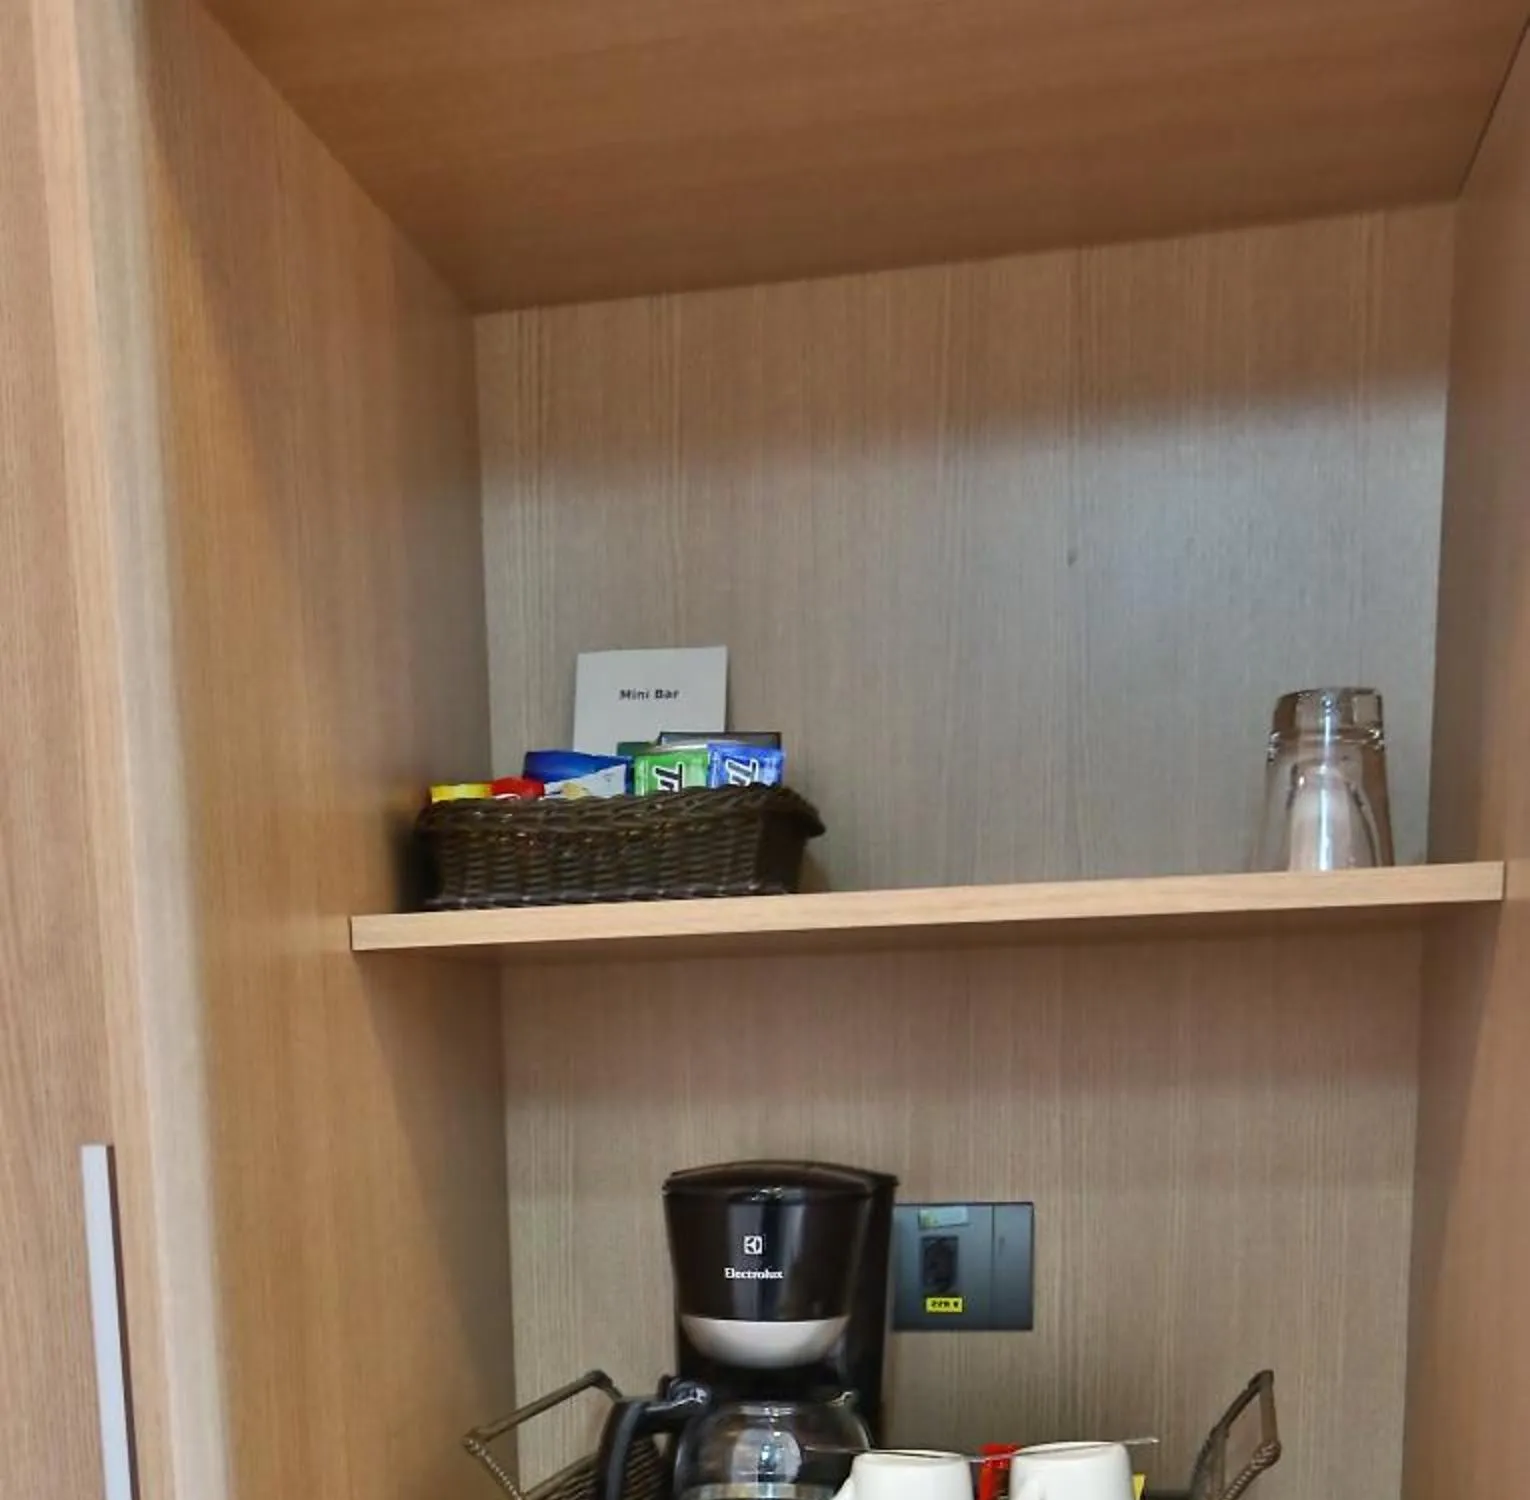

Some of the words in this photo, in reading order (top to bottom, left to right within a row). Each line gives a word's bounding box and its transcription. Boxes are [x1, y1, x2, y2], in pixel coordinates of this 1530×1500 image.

[619, 688, 649, 700] Mini
[655, 689, 680, 700] Bar
[724, 1267, 784, 1279] Electrolux
